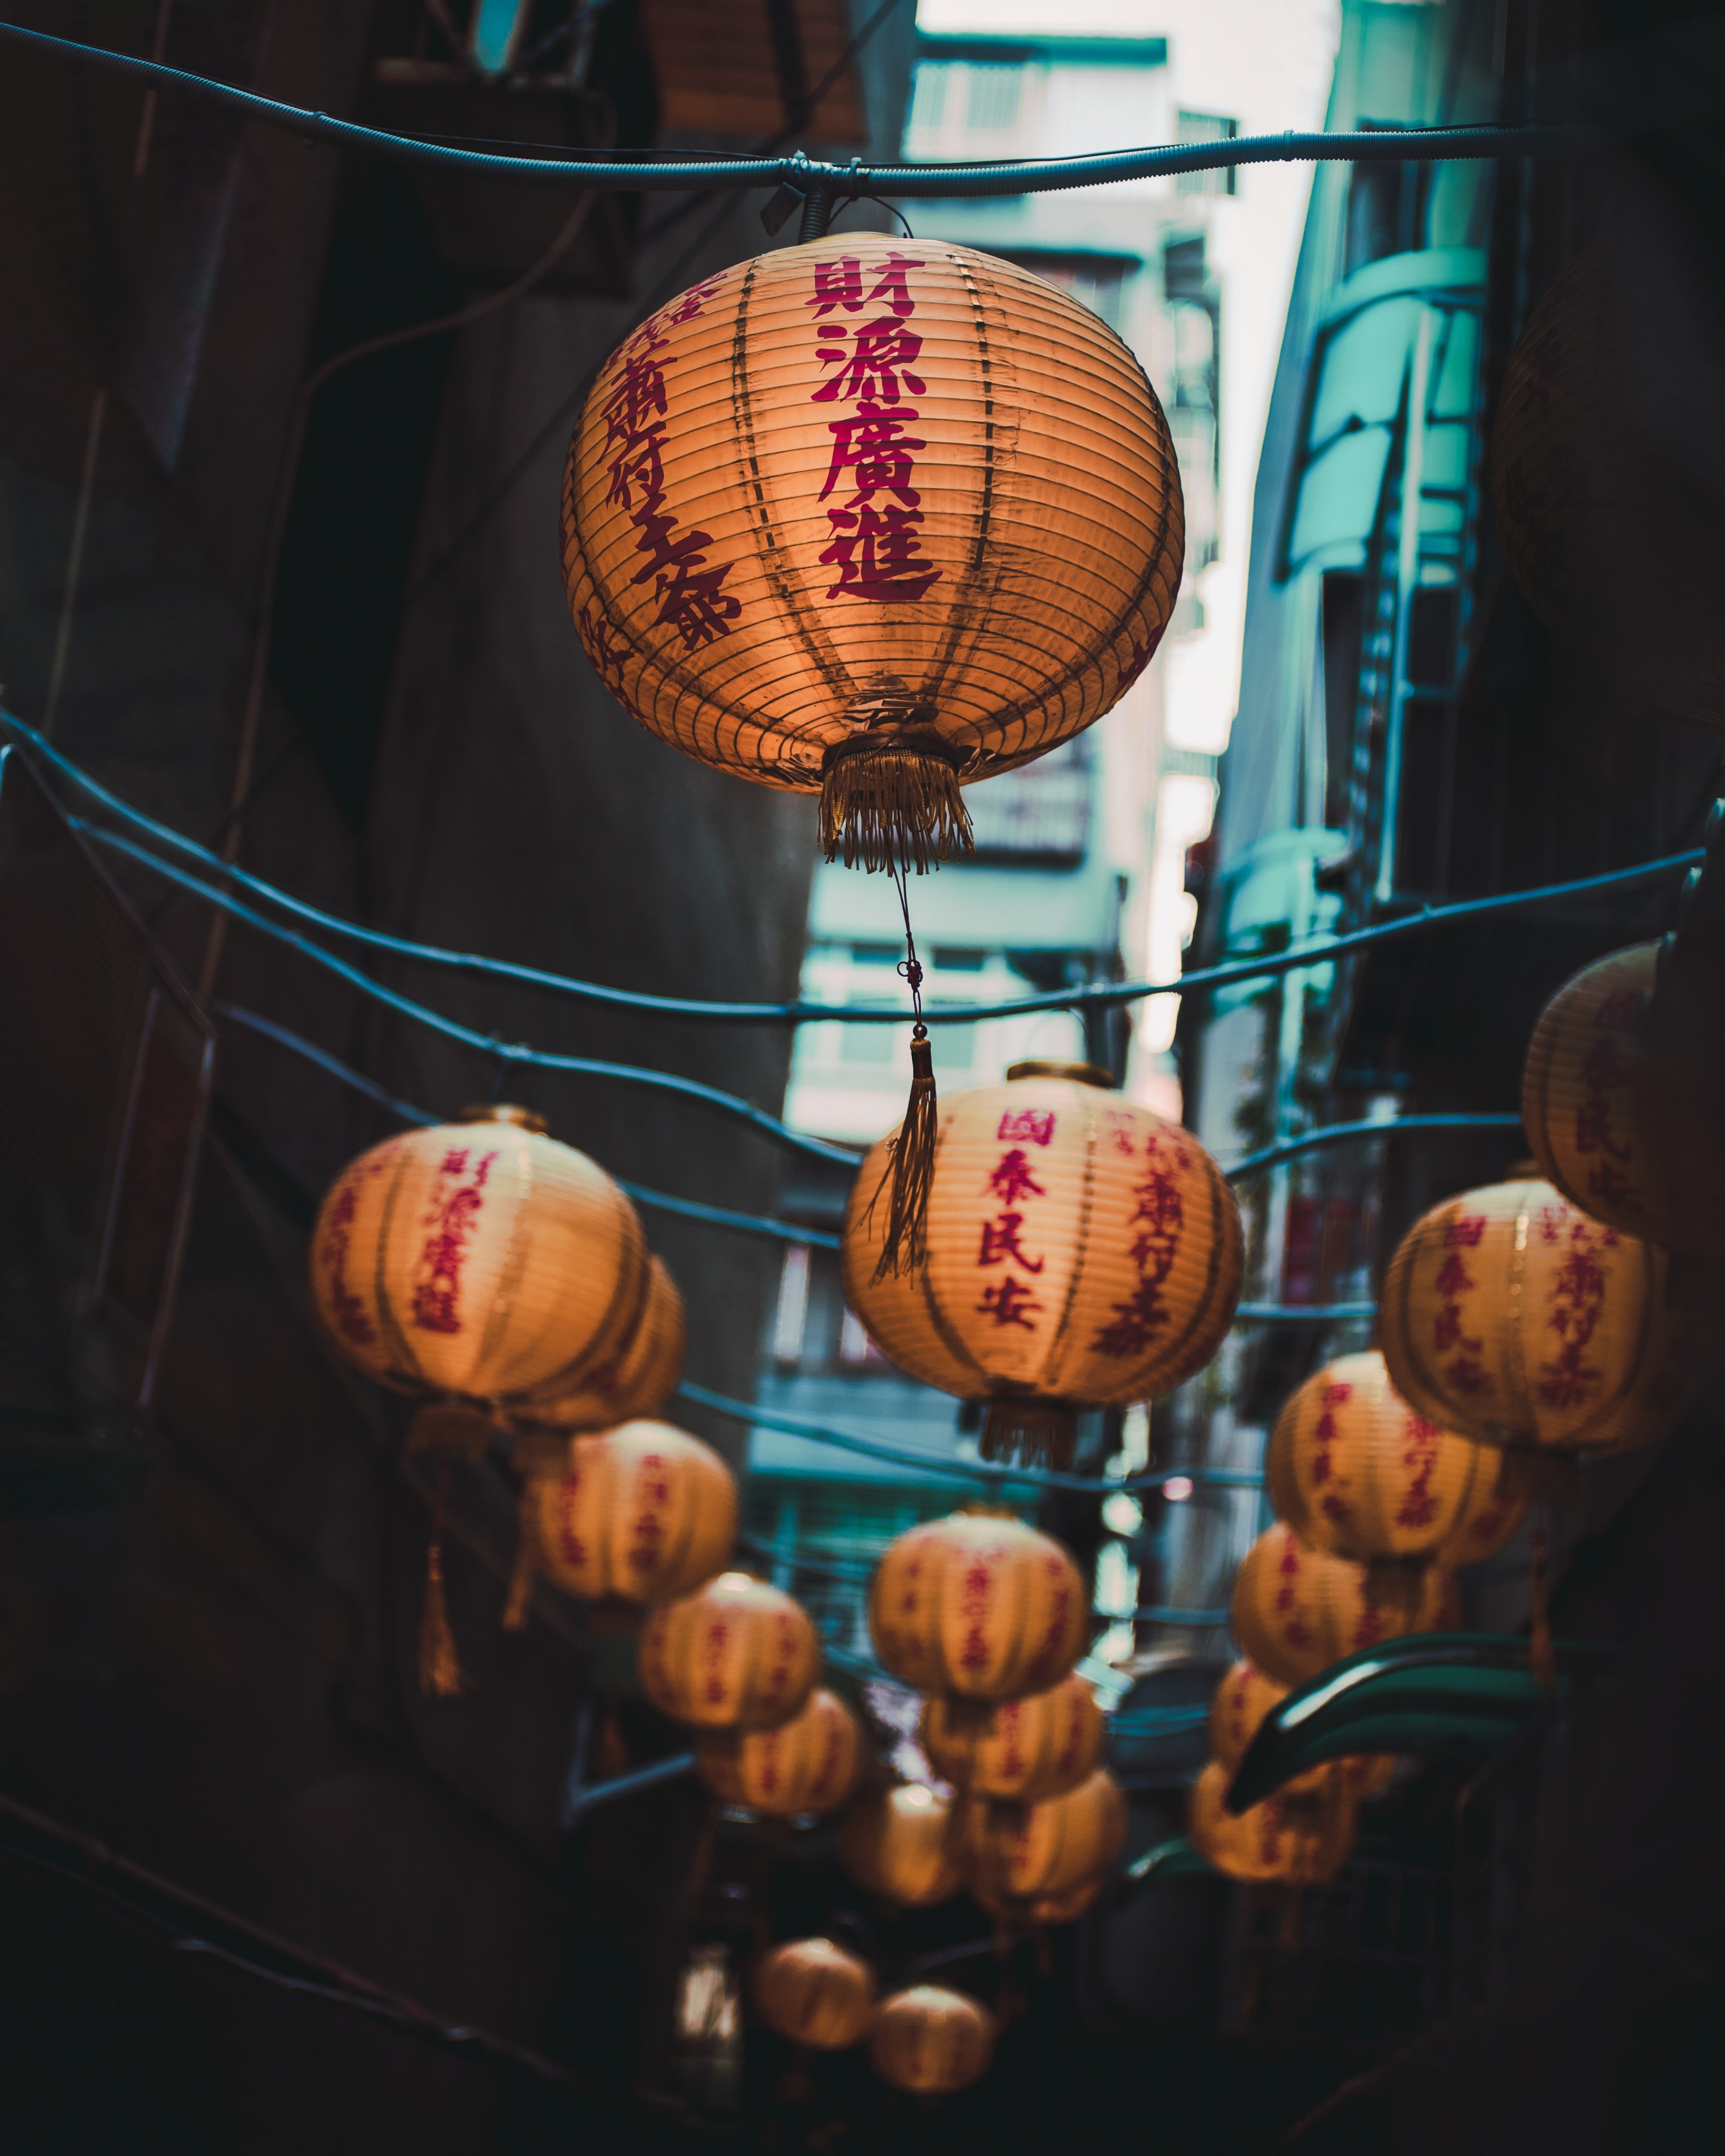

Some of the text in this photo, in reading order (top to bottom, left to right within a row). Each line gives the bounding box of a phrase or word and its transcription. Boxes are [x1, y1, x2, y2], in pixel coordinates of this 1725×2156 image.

[804, 252, 943, 602] 財源廣進
[977, 1109, 1057, 1331] 國泰民安
